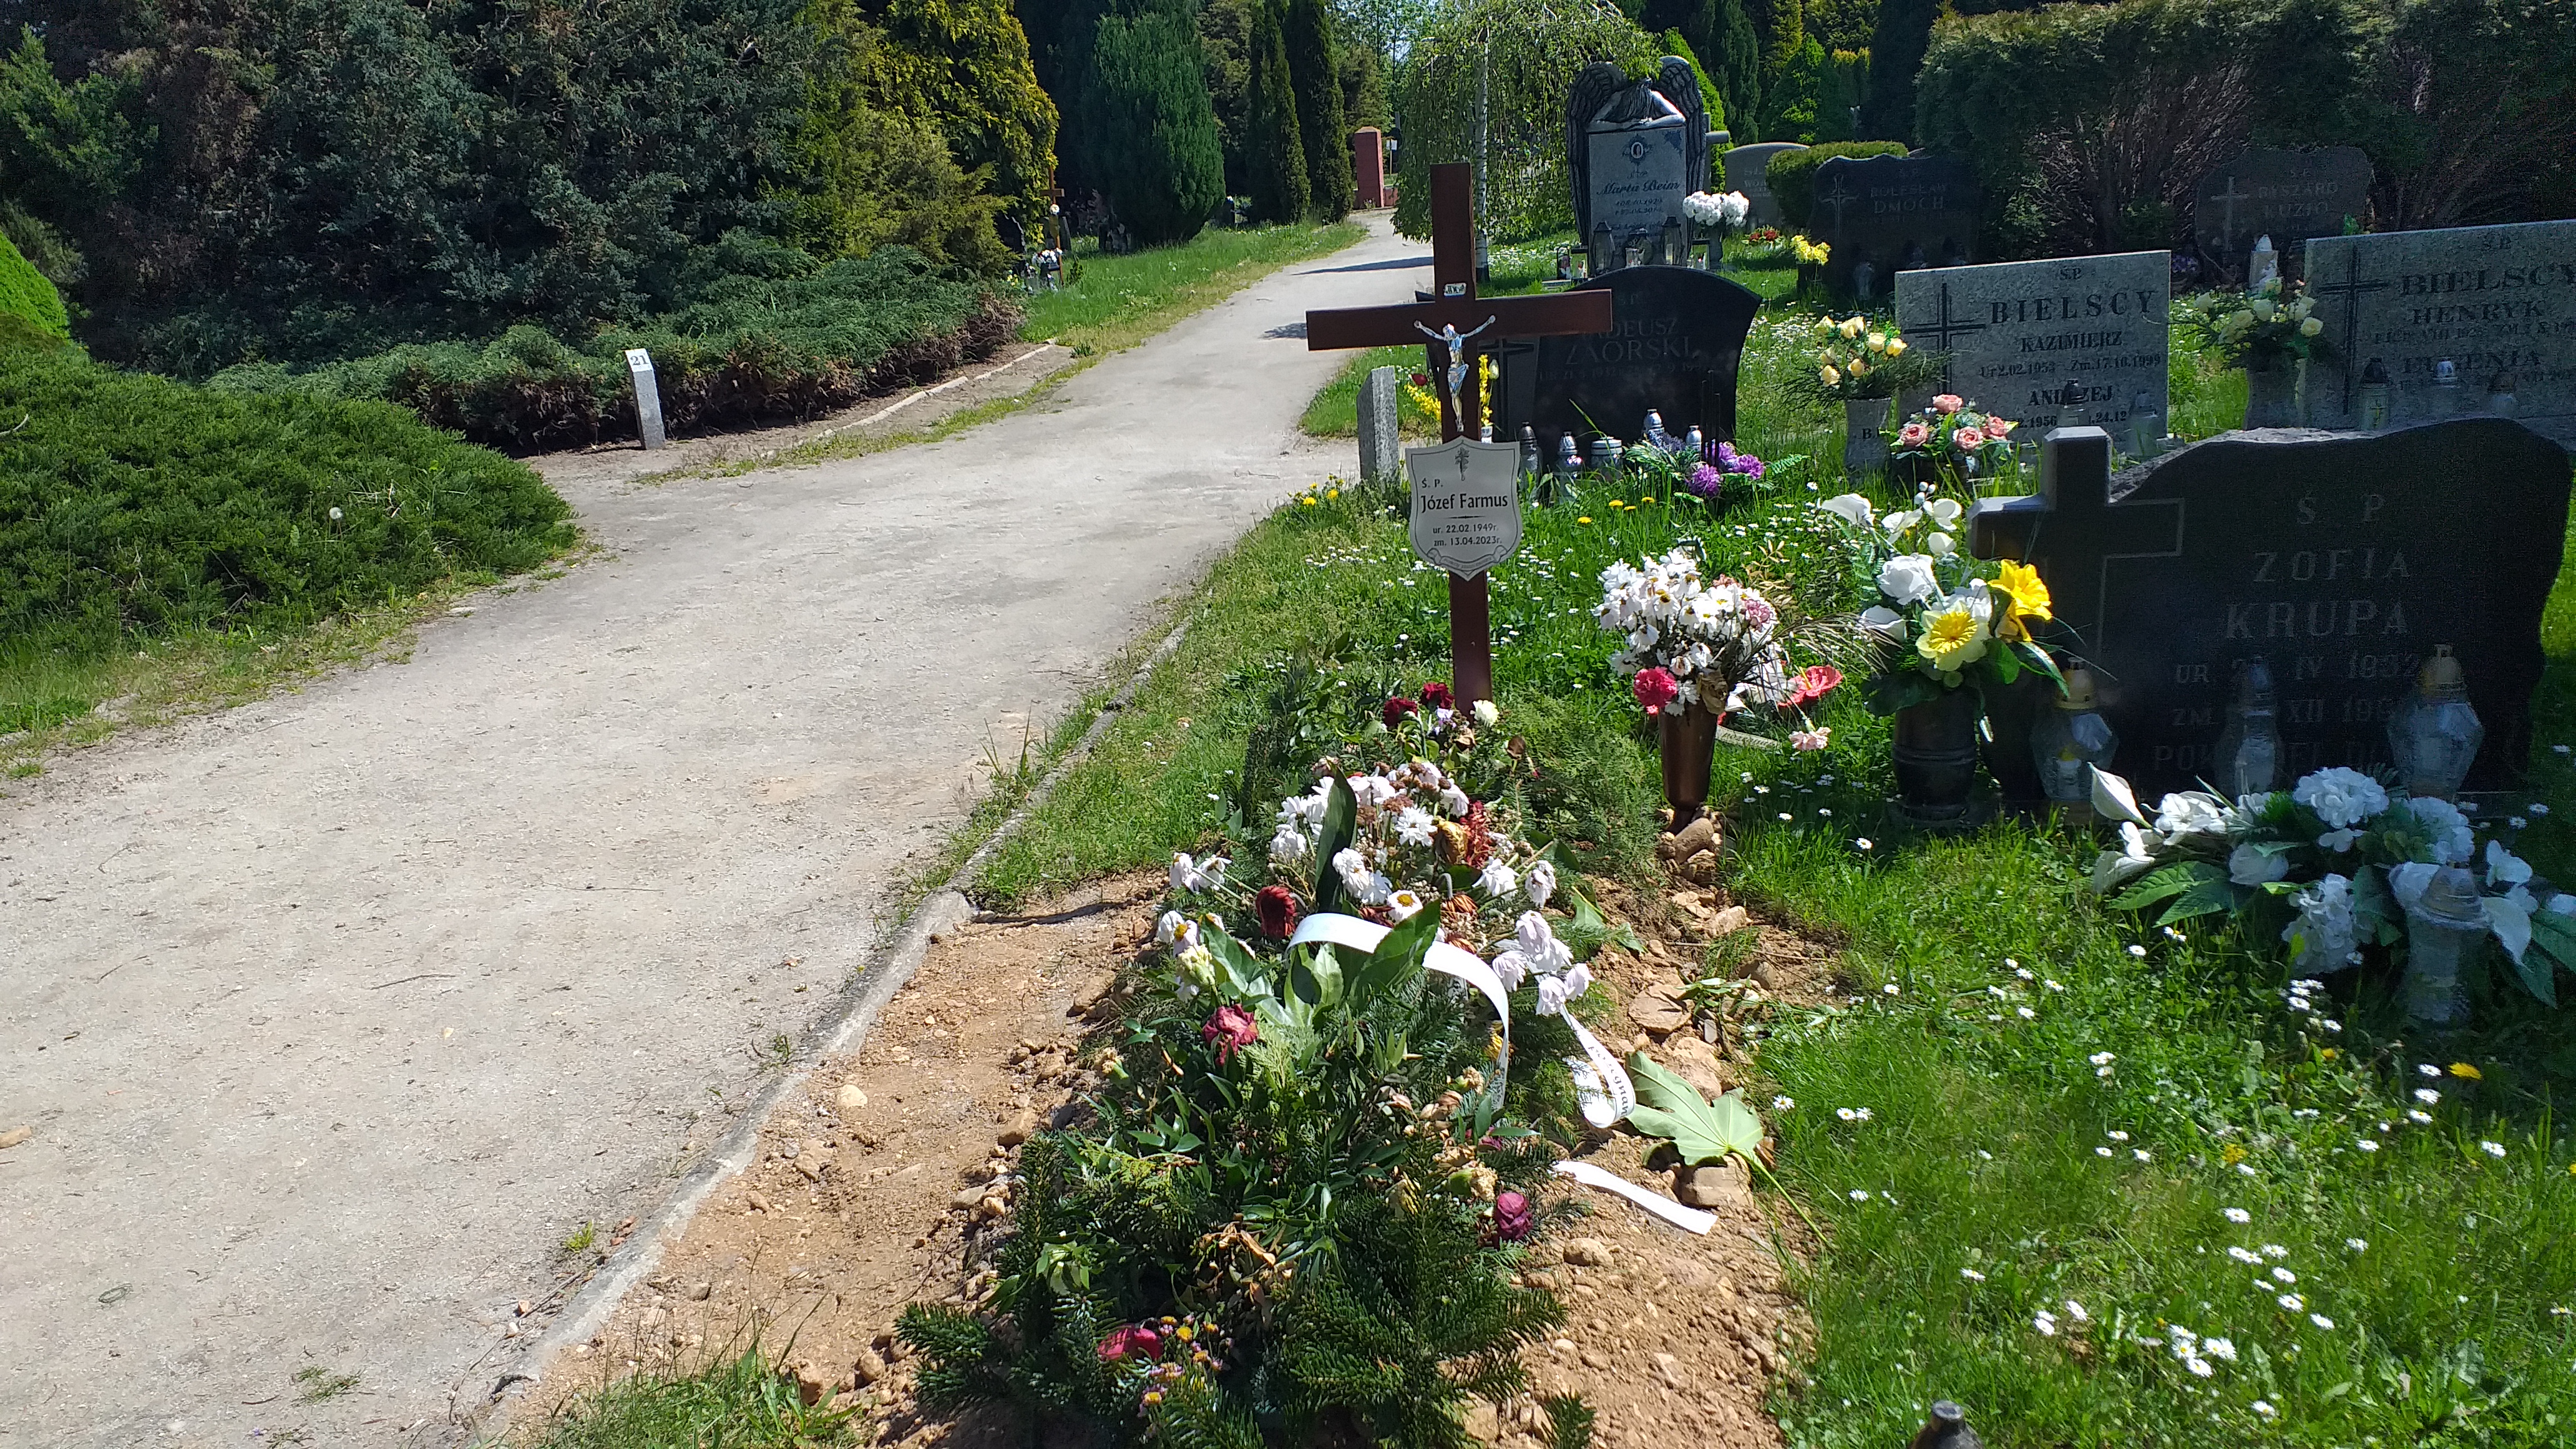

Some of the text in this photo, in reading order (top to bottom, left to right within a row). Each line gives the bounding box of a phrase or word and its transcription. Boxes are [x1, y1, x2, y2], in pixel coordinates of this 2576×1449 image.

[1874, 195, 1944, 214] DMOCH
[1991, 290, 2159, 324] BIELSCY
[2412, 300, 2546, 325] HENRYK
[1565, 336, 1690, 365] ZAORSKI
[2021, 331, 2123, 353] KAZIMIERZ
[630, 354, 649, 366] 21
[1434, 478, 1443, 488] P.
[1421, 493, 1508, 513] Józef Farmus
[2362, 492, 2385, 523] P
[1433, 523, 1499, 535] ur. 22.02.1949r.
[1433, 535, 1503, 547] zm. 13.04.2023r.
[2253, 547, 2412, 583] ZOFIA
[2224, 599, 2409, 639] KRUPA
